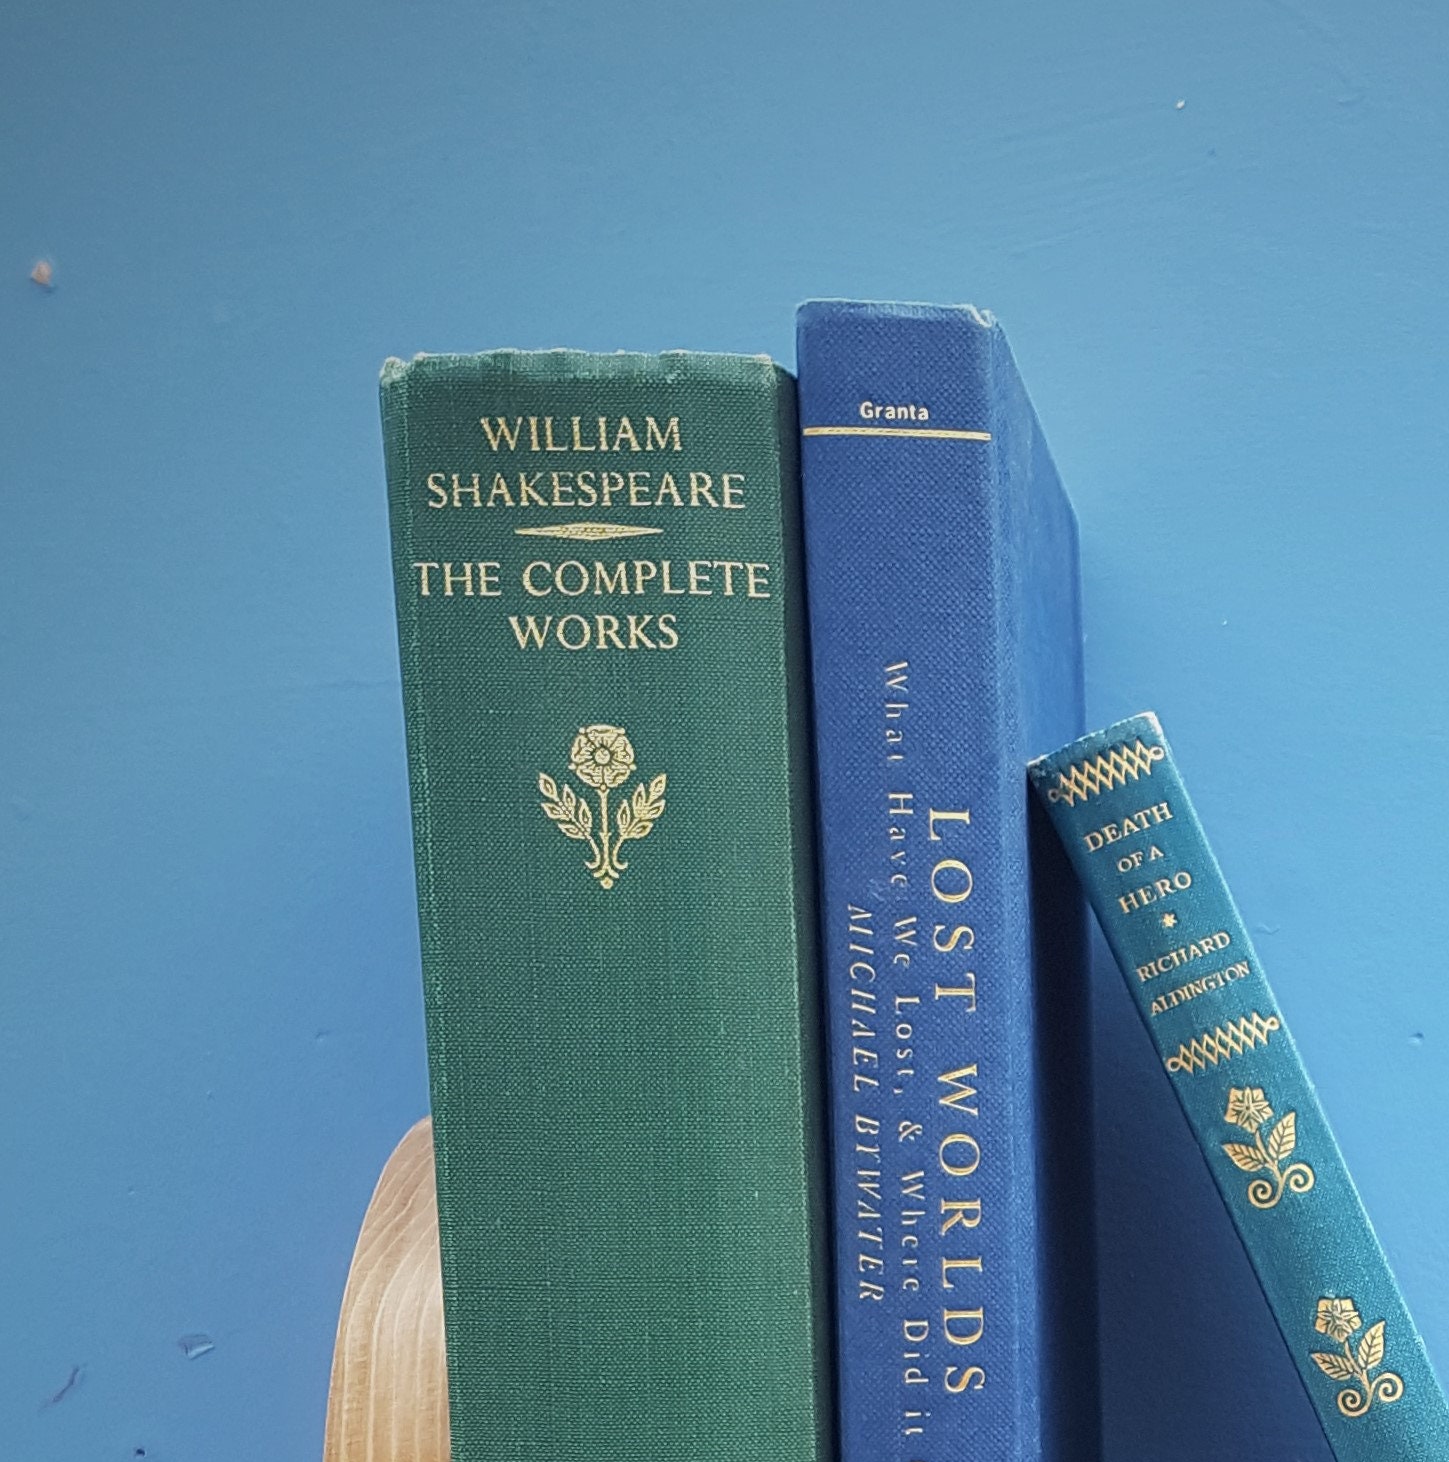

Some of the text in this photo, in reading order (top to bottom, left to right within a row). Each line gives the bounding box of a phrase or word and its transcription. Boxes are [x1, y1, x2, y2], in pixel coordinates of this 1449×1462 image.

[480, 416, 683, 452] WILLIAM
[860, 401, 929, 421] Granta
[426, 472, 747, 509] SHAKESPEARE
[413, 561, 771, 598] THE COMPLETE
[509, 614, 679, 651] WORKS
[885, 661, 909, 761] What
[888, 792, 914, 886] Have
[1084, 802, 1173, 852] DEATH
[1116, 845, 1165, 874] OF A
[1118, 870, 1192, 914] HERO
[893, 916, 917, 966] We
[1136, 931, 1231, 982] RICHARD
[1149, 960, 1250, 1017] ALDINGTON
[894, 996, 920, 1095] Lost,
[847, 904, 885, 1302] MICHAEL BYWATER
[929, 807, 986, 1393] LOST WORLDS
[899, 1120, 923, 1142] &
[901, 1170, 926, 1293] Where
[903, 1320, 929, 1385] Did
[905, 1411, 931, 1435] it
